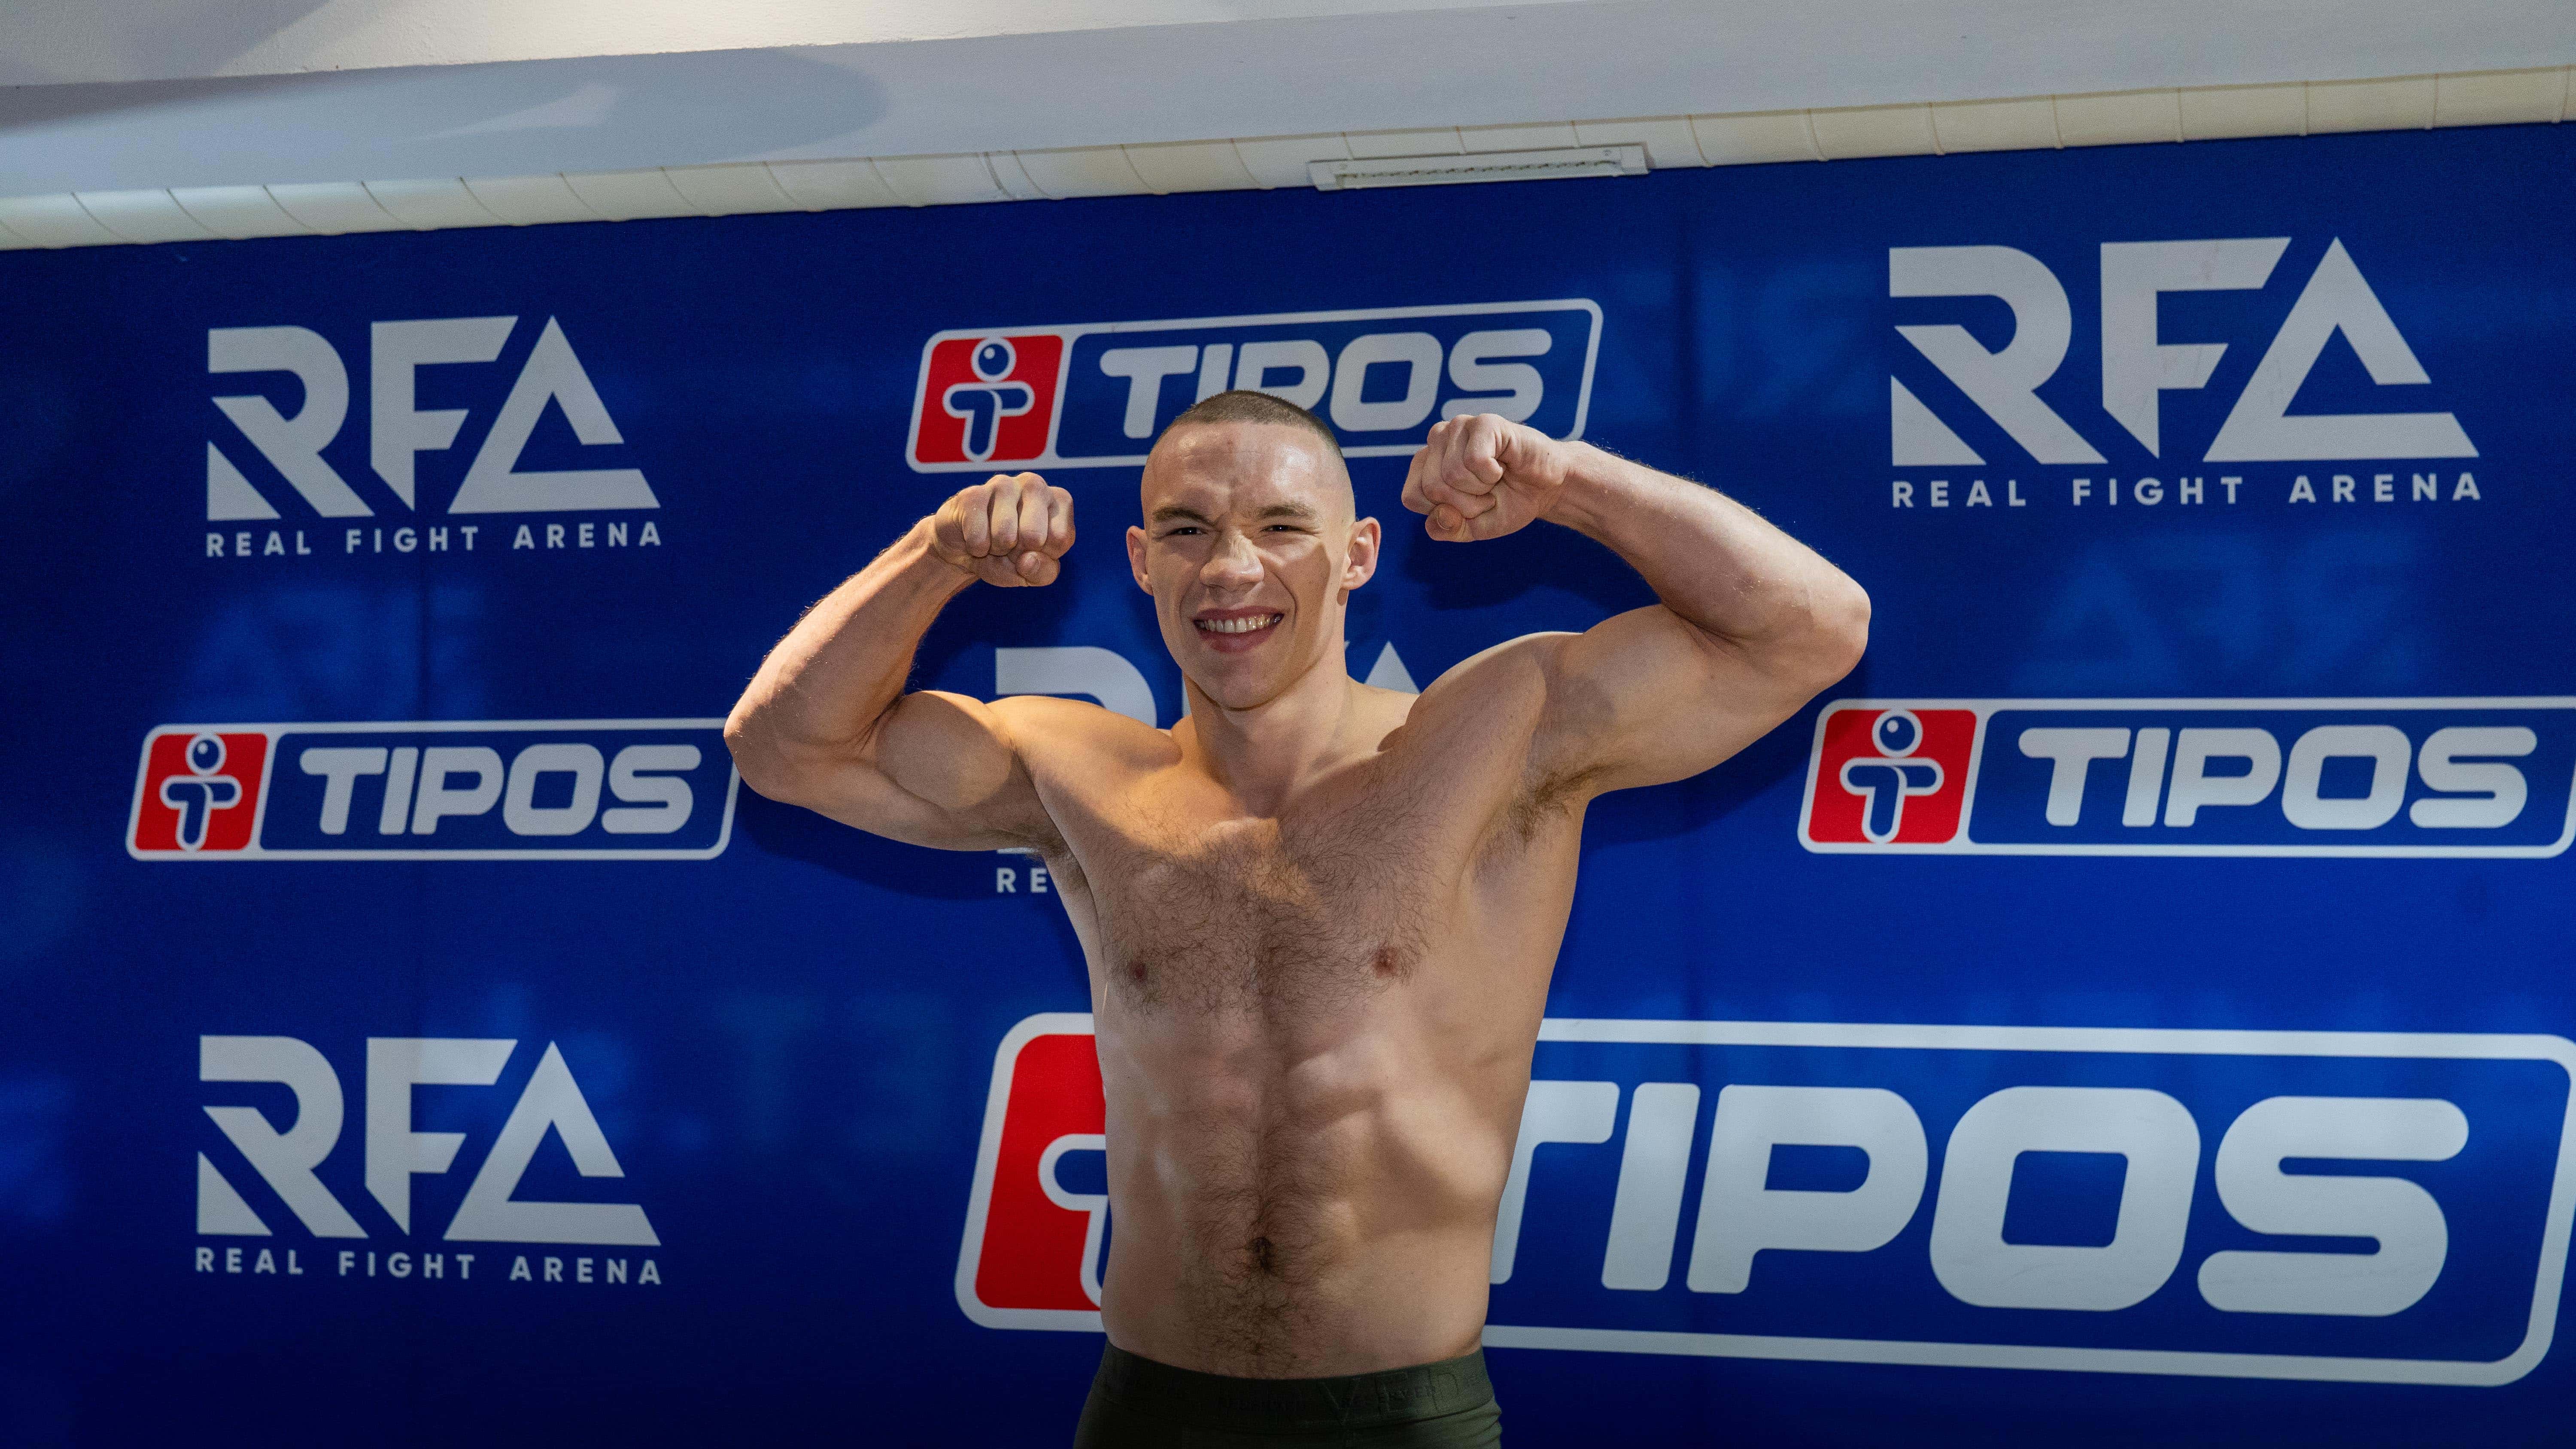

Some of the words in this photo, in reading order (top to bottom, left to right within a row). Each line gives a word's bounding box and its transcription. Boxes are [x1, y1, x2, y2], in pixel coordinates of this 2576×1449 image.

[1100, 329, 1552, 438] TIPOS
[1889, 237, 2479, 466] RFA
[208, 316, 660, 521] RFA
[207, 531, 310, 556] REAL
[347, 527, 478, 553] FIGHT
[514, 522, 660, 549] ARENA
[1893, 480, 2026, 507] REAL
[2073, 477, 2242, 505] FIGHT
[2289, 473, 2480, 503] ARENA
[300, 744, 701, 835] TIPOS
[2018, 725, 2537, 830] TIPOS
[996, 868, 1048, 893] RE
[198, 1036, 660, 1245] RFA
[197, 1248, 302, 1273] REAL
[340, 1252, 474, 1278] FIGHT
[511, 1257, 660, 1284] ARENA
